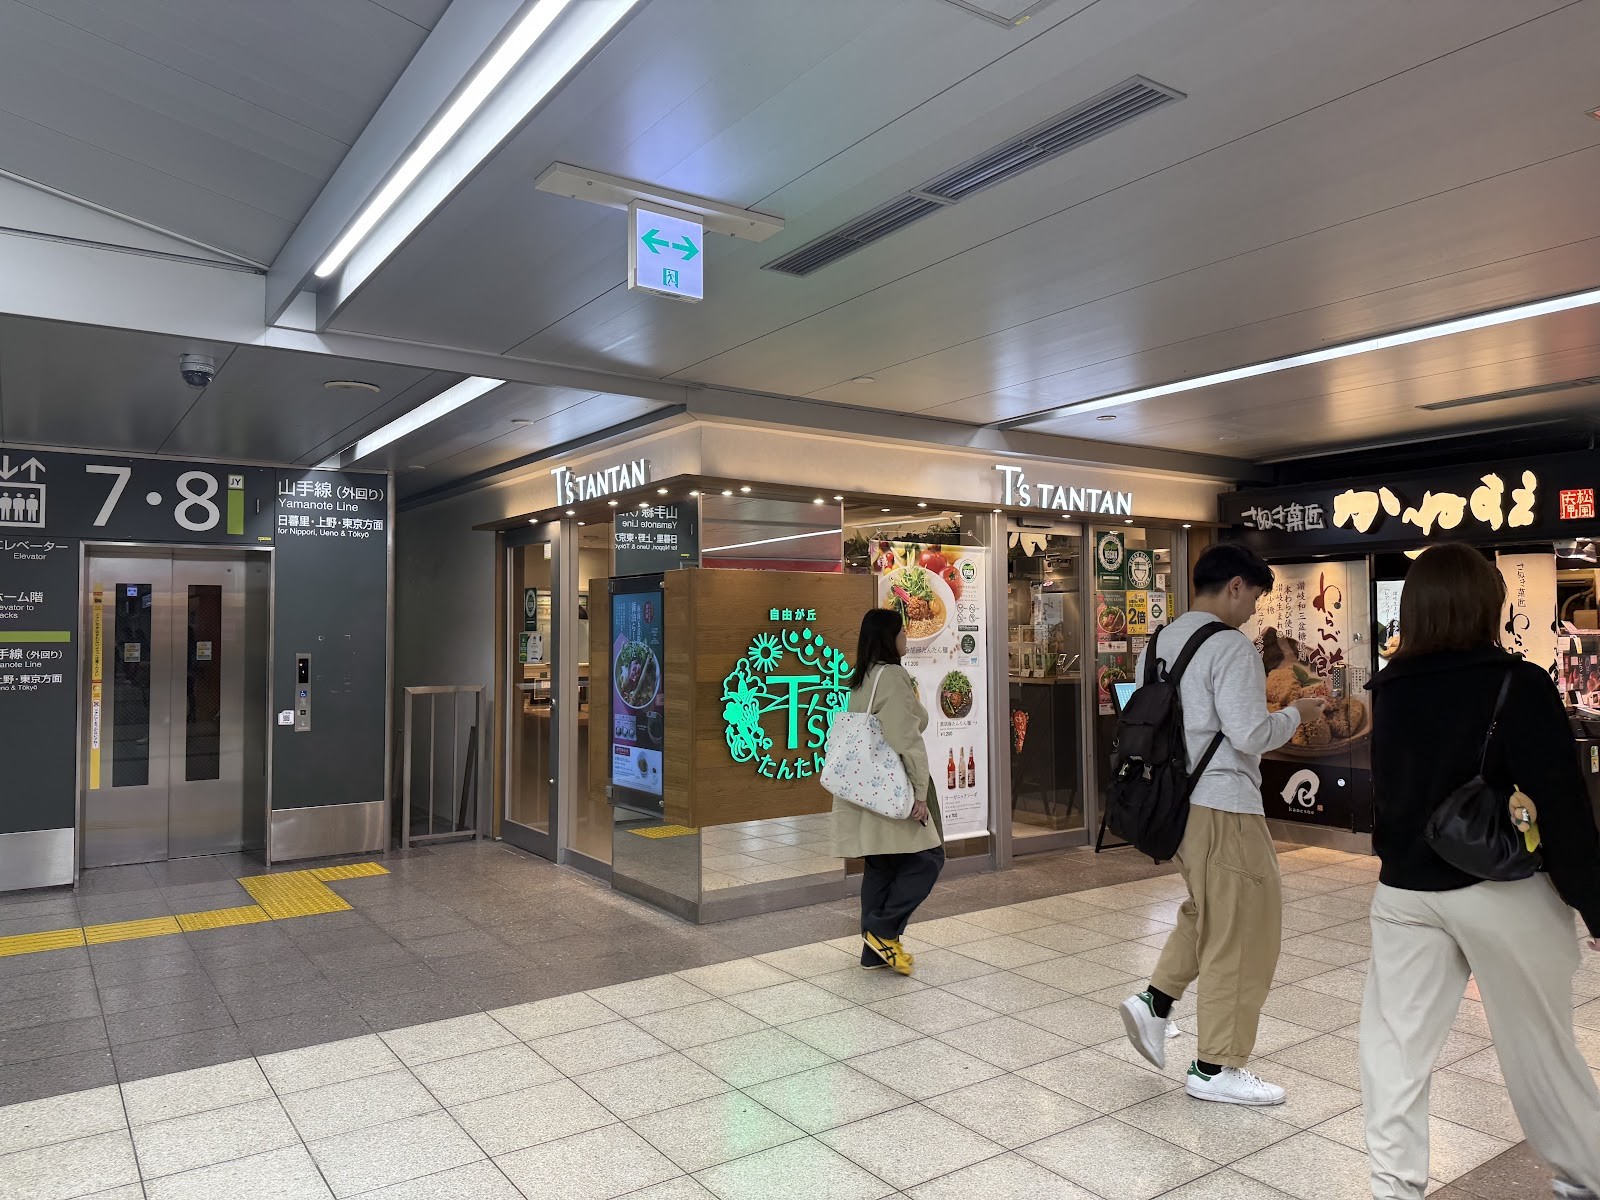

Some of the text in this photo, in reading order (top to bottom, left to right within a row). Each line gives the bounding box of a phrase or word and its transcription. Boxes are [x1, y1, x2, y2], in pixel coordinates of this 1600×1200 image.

[551, 459, 645, 505] T's TANTAN
[996, 465, 1132, 515] T's TANTAN
[279, 498, 359, 511] Yamanote Line
[1241, 502, 1324, 532] さぬき菓匠
[278, 515, 383, 530] 日暮里・上野・東京方面
[289, 528, 318, 536] Nippori,
[769, 608, 817, 621] 自由が丘
[1128, 608, 1146, 625] 2倍
[1285, 585, 1293, 638] 本わらび使用
[1309, 572, 1344, 677] わらび餅
[766, 675, 825, 749] T's
